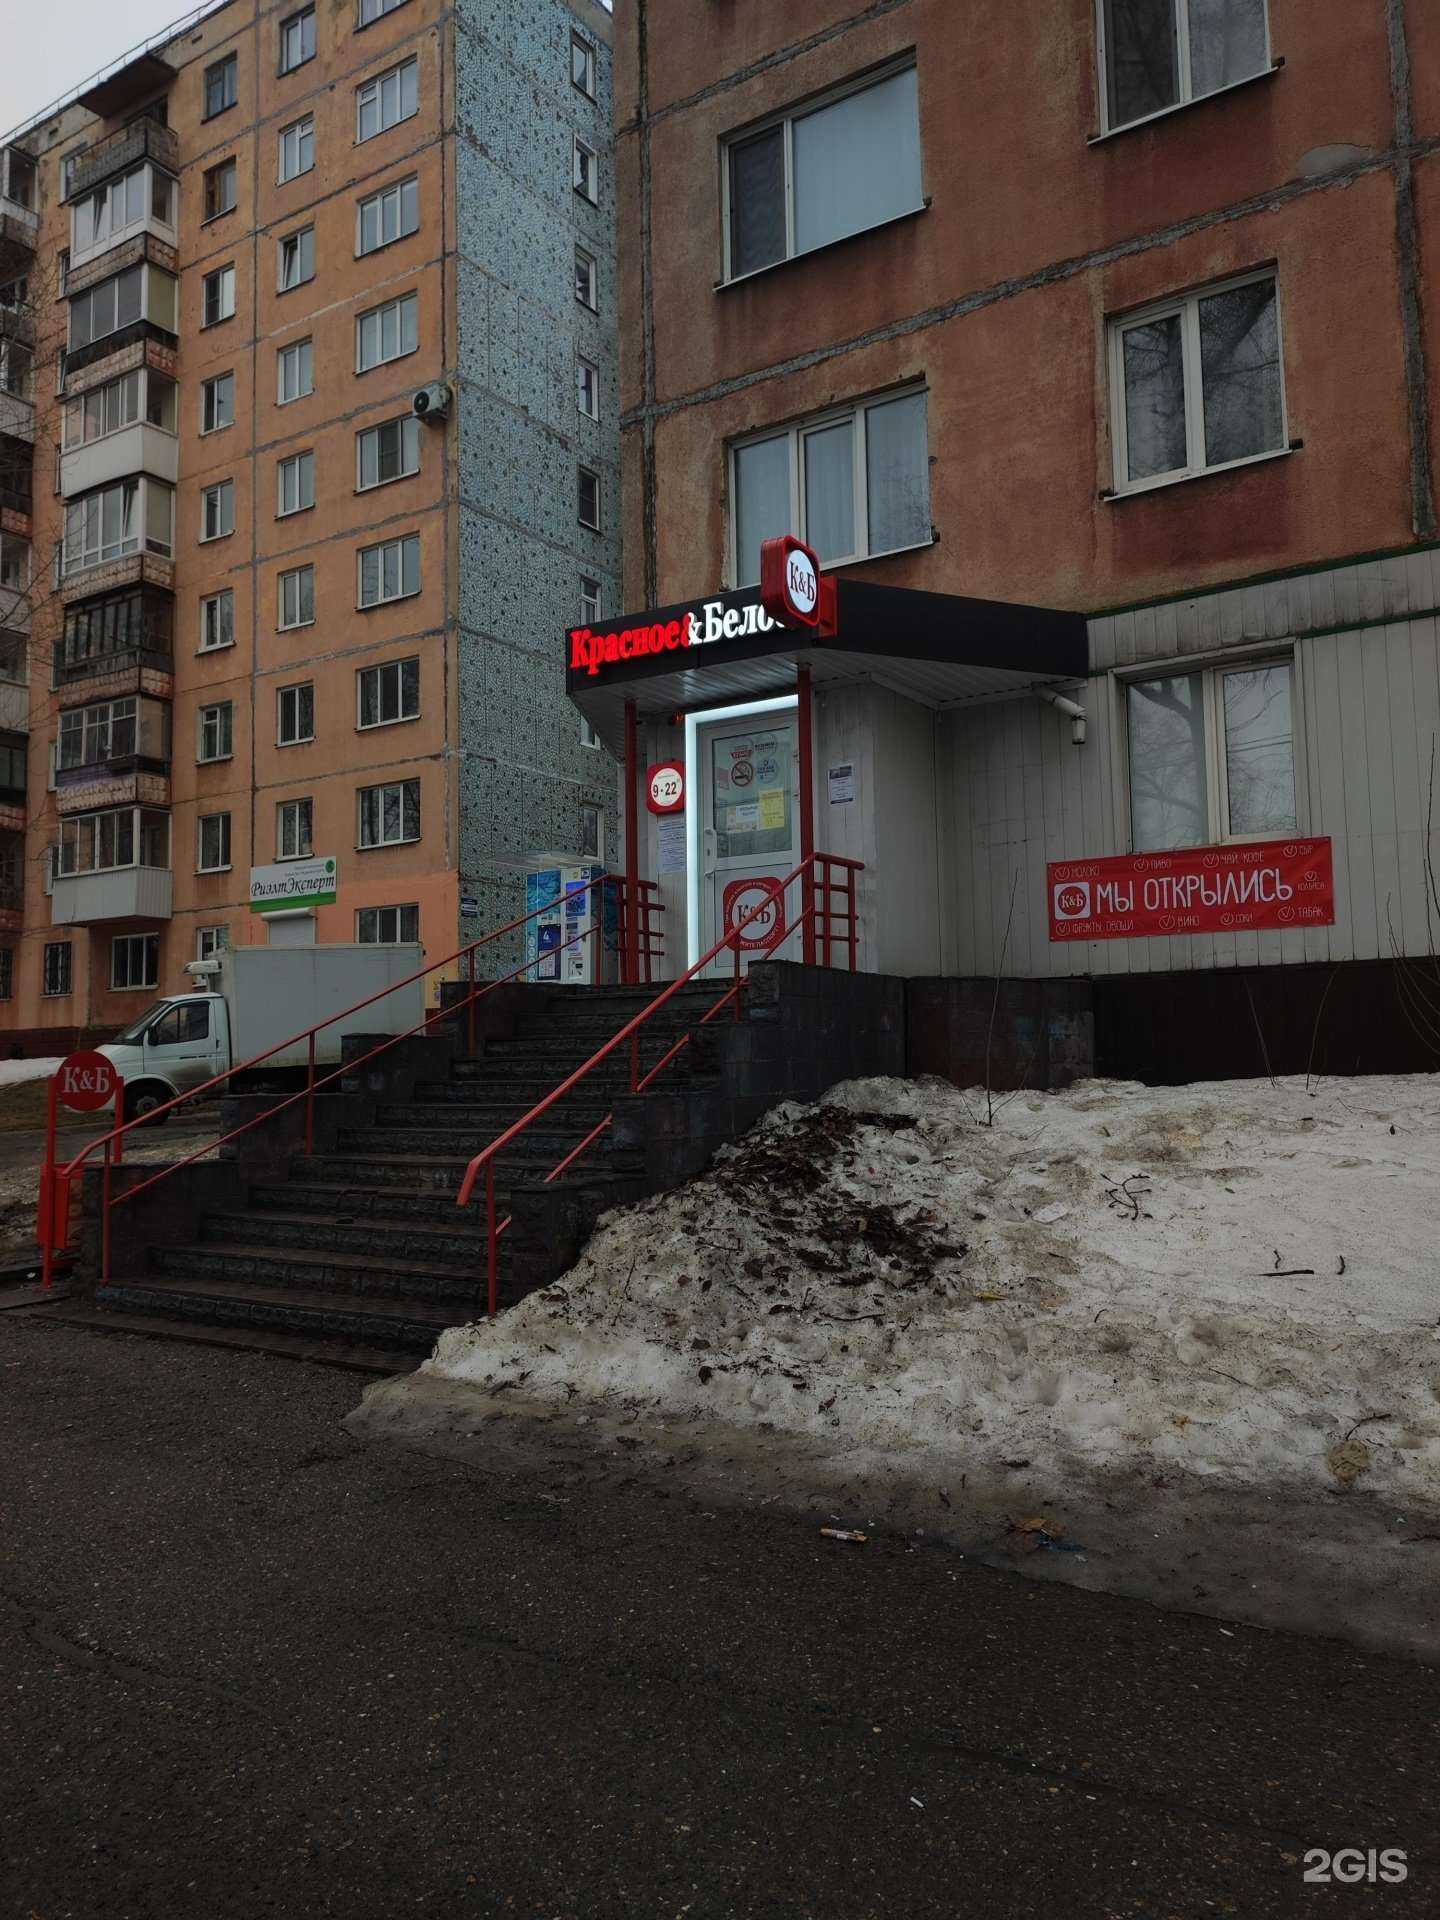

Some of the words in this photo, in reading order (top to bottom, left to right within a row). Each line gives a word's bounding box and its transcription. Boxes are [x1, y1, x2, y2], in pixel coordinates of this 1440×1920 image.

[790, 561, 816, 603] К&Б
[570, 601, 785, 675] Красное&Бело
[251, 875, 335, 897] РиэлтЭксперт
[1061, 892, 1084, 908] К&Б
[1096, 880, 1134, 914] МЫ
[1144, 867, 1294, 910] ОТКРЫЛИСЬ
[63, 1066, 110, 1094] К&Б
